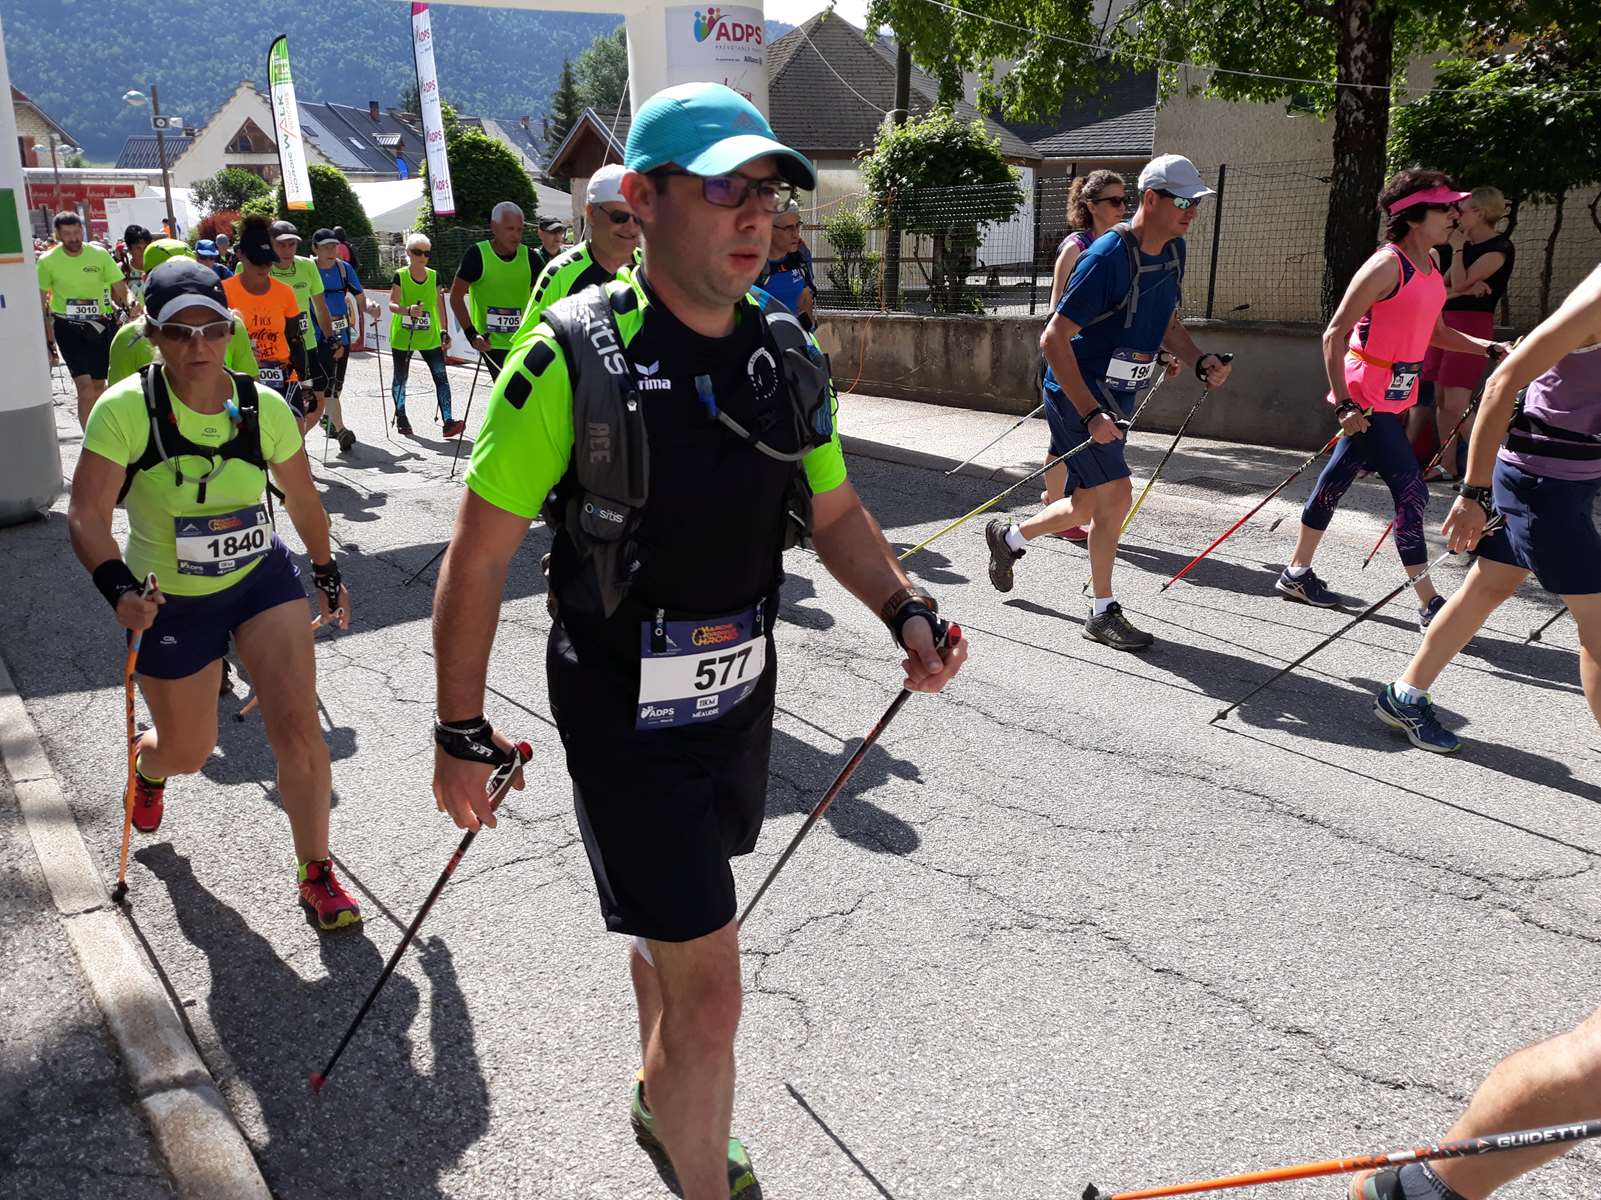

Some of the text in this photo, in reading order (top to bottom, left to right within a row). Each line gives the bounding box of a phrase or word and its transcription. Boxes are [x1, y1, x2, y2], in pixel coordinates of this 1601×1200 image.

[715, 22, 763, 45] ADPS
[76, 305, 97, 314] 3010
[497, 317, 519, 325] 1705
[636, 377, 671, 390] rima
[208, 529, 264, 558] 1840
[694, 646, 753, 691] 577
[649, 707, 675, 718] ADPS
[1497, 1124, 1588, 1148] GUIDETTI
